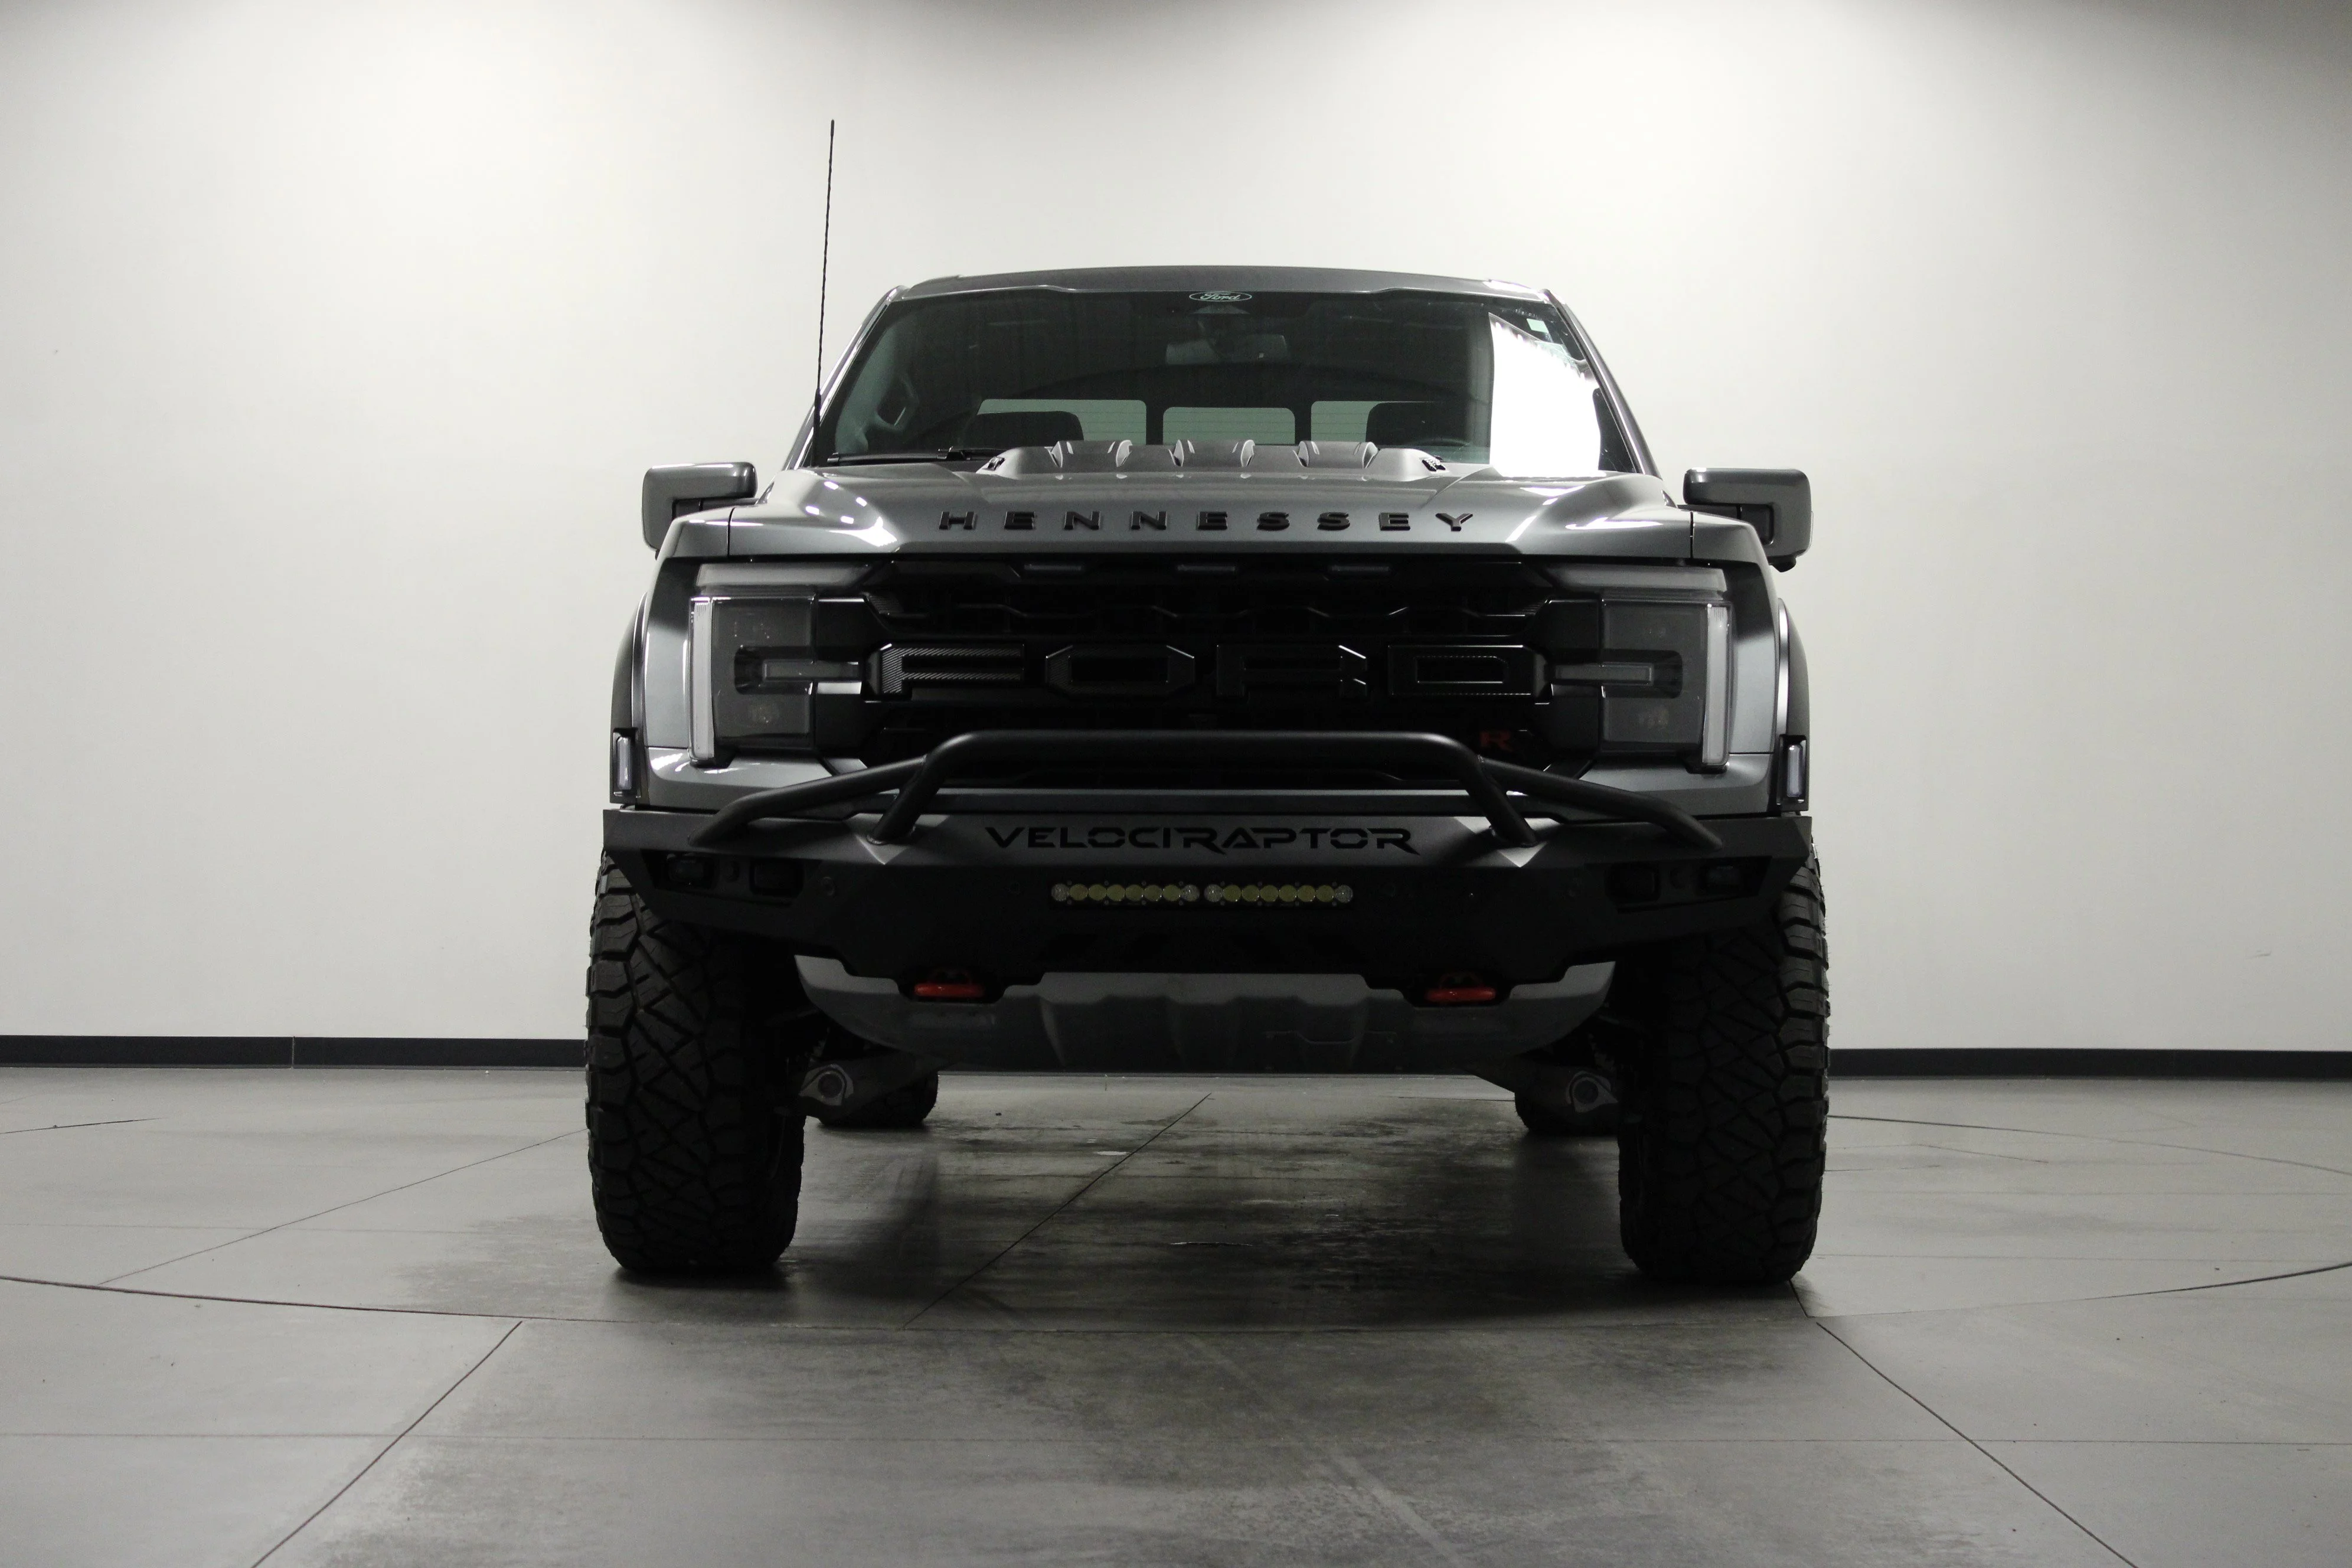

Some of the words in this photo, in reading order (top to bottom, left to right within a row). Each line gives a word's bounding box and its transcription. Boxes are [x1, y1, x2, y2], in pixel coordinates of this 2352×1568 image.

[1200, 292, 1241, 300] Ford
[939, 511, 1474, 532] HENNESSEY
[878, 643, 1538, 698] FORD
[1479, 730, 1513, 753] R
[985, 827, 1420, 855] VELOCIRAPTOR
